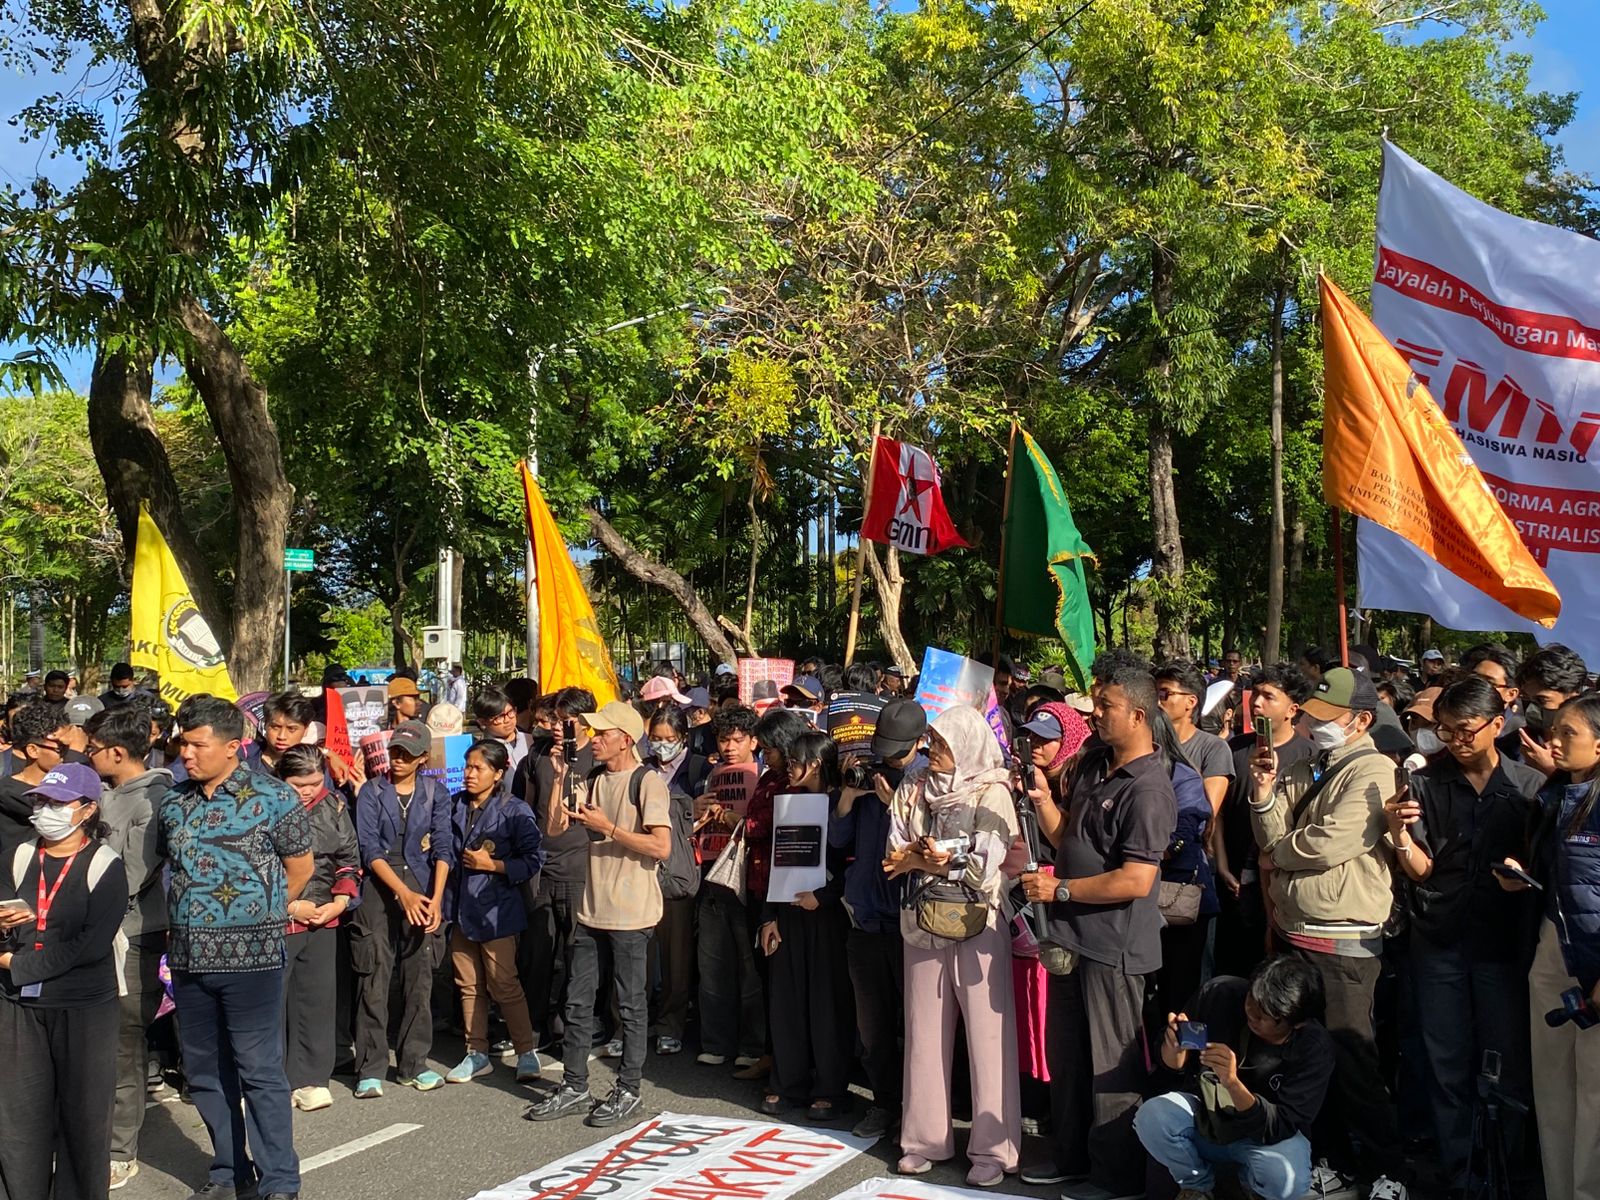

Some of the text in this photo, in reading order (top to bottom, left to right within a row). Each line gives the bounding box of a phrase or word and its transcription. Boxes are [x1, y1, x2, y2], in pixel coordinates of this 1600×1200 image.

[1381, 260, 1453, 300] Jayalah
[1459, 288, 1558, 345] Perjuangan
[1512, 519, 1600, 544] STRIALIS
[640, 1127, 845, 1200] AKYAT
